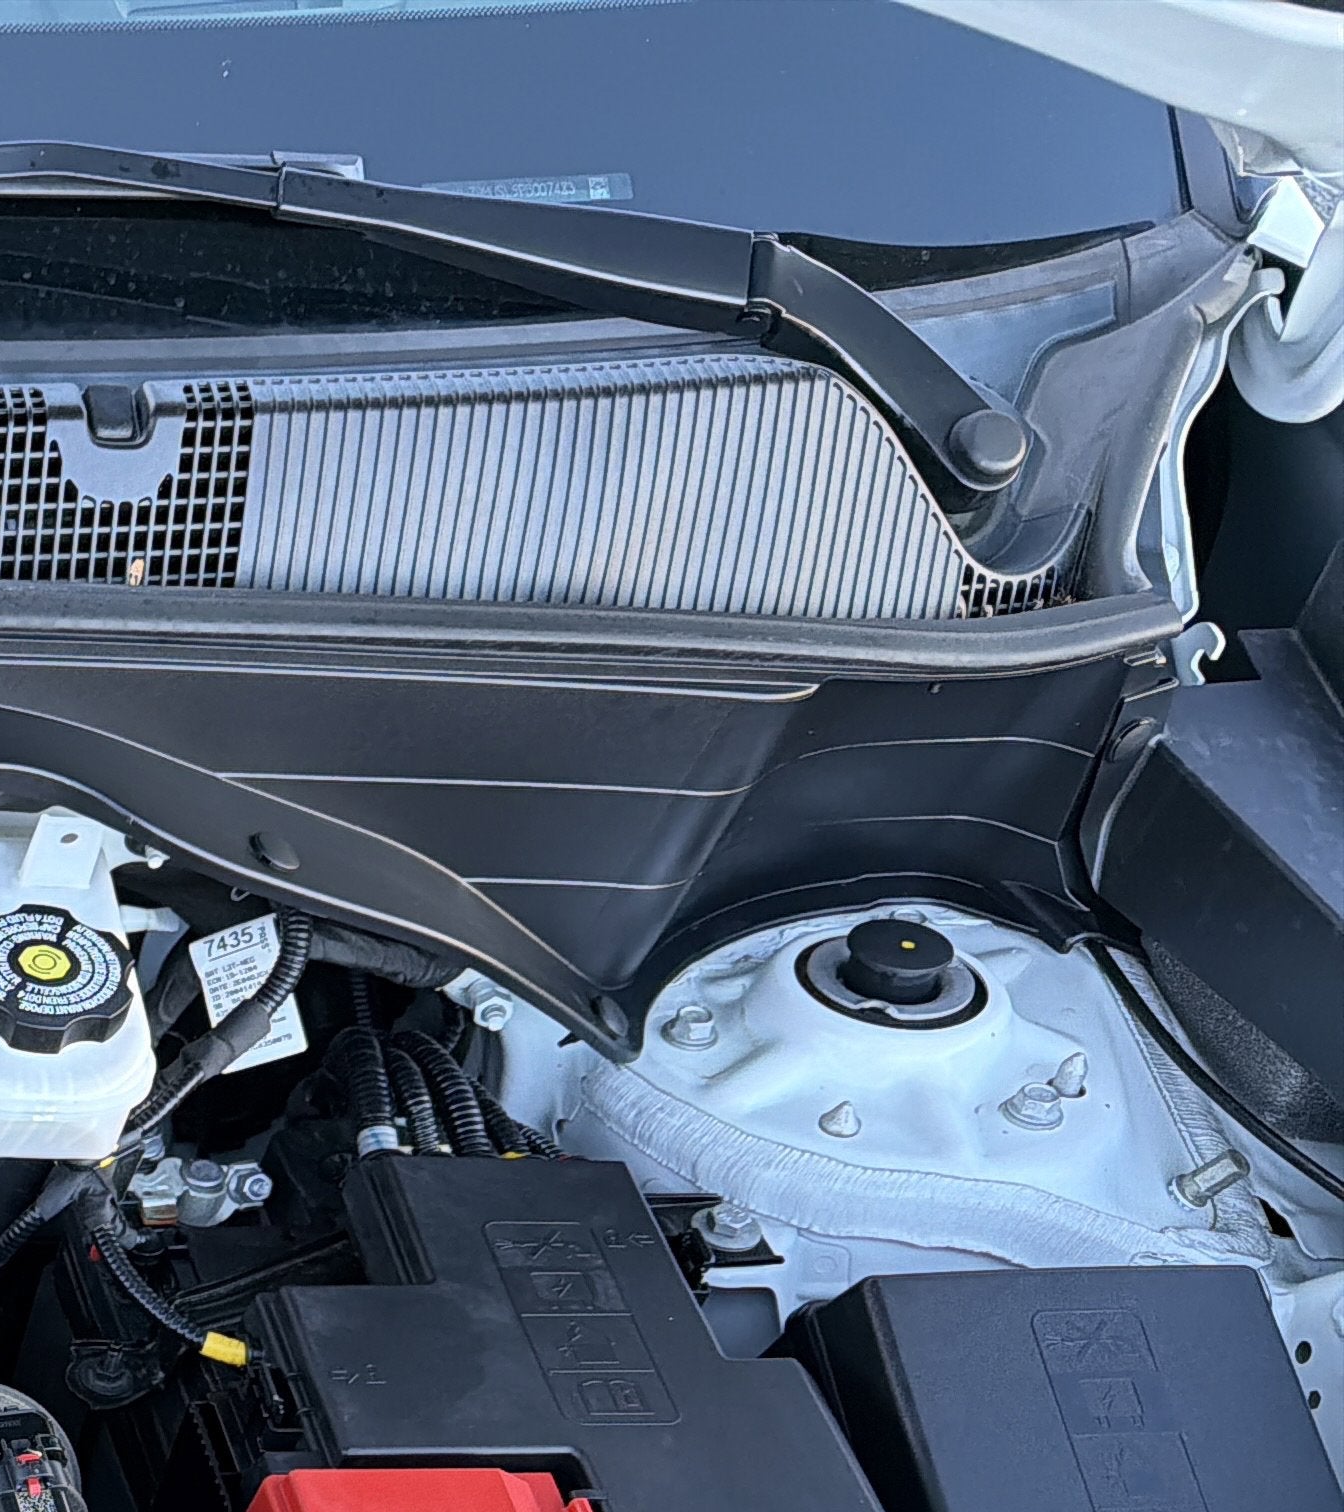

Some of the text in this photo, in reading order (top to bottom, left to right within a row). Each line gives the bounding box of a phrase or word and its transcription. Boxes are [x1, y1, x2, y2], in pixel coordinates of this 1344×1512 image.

[4, 913, 34, 923] FLUID
[41, 914, 64, 925] DOT
[37, 923, 62, 933] CAP
[203, 926, 255, 957] 7435
